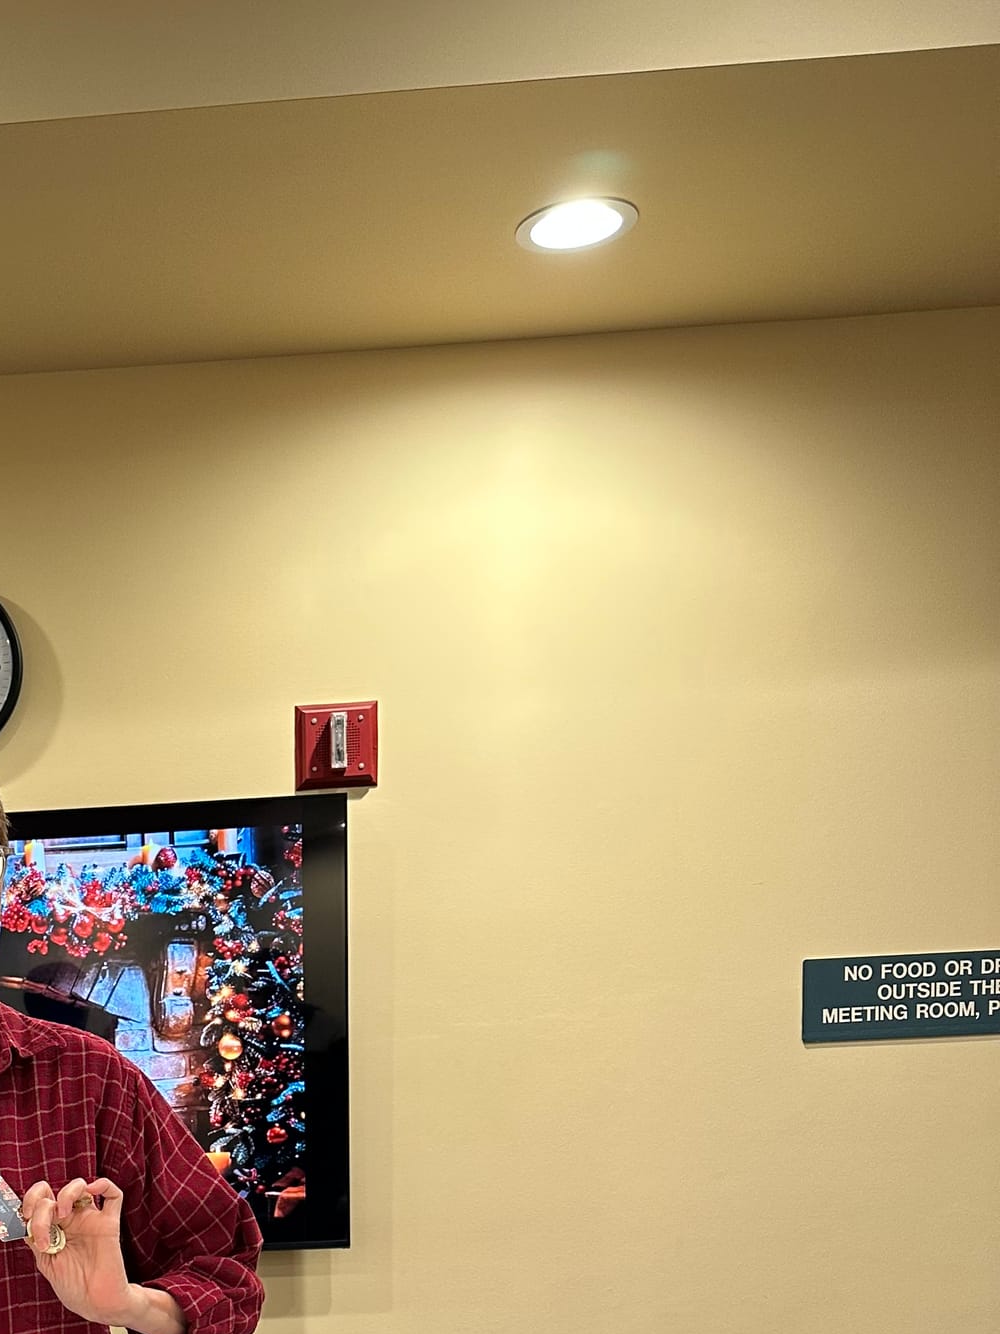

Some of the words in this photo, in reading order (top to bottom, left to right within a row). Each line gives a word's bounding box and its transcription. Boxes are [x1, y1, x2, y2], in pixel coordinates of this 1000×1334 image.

[844, 964, 873, 982] NO
[881, 962, 937, 979] FOOD
[944, 960, 973, 976] OR
[877, 981, 962, 1000] OUTSIDE
[970, 979, 1000, 996] THE
[822, 1004, 908, 1024] MEETING
[916, 1001, 980, 1020] ROOM,
